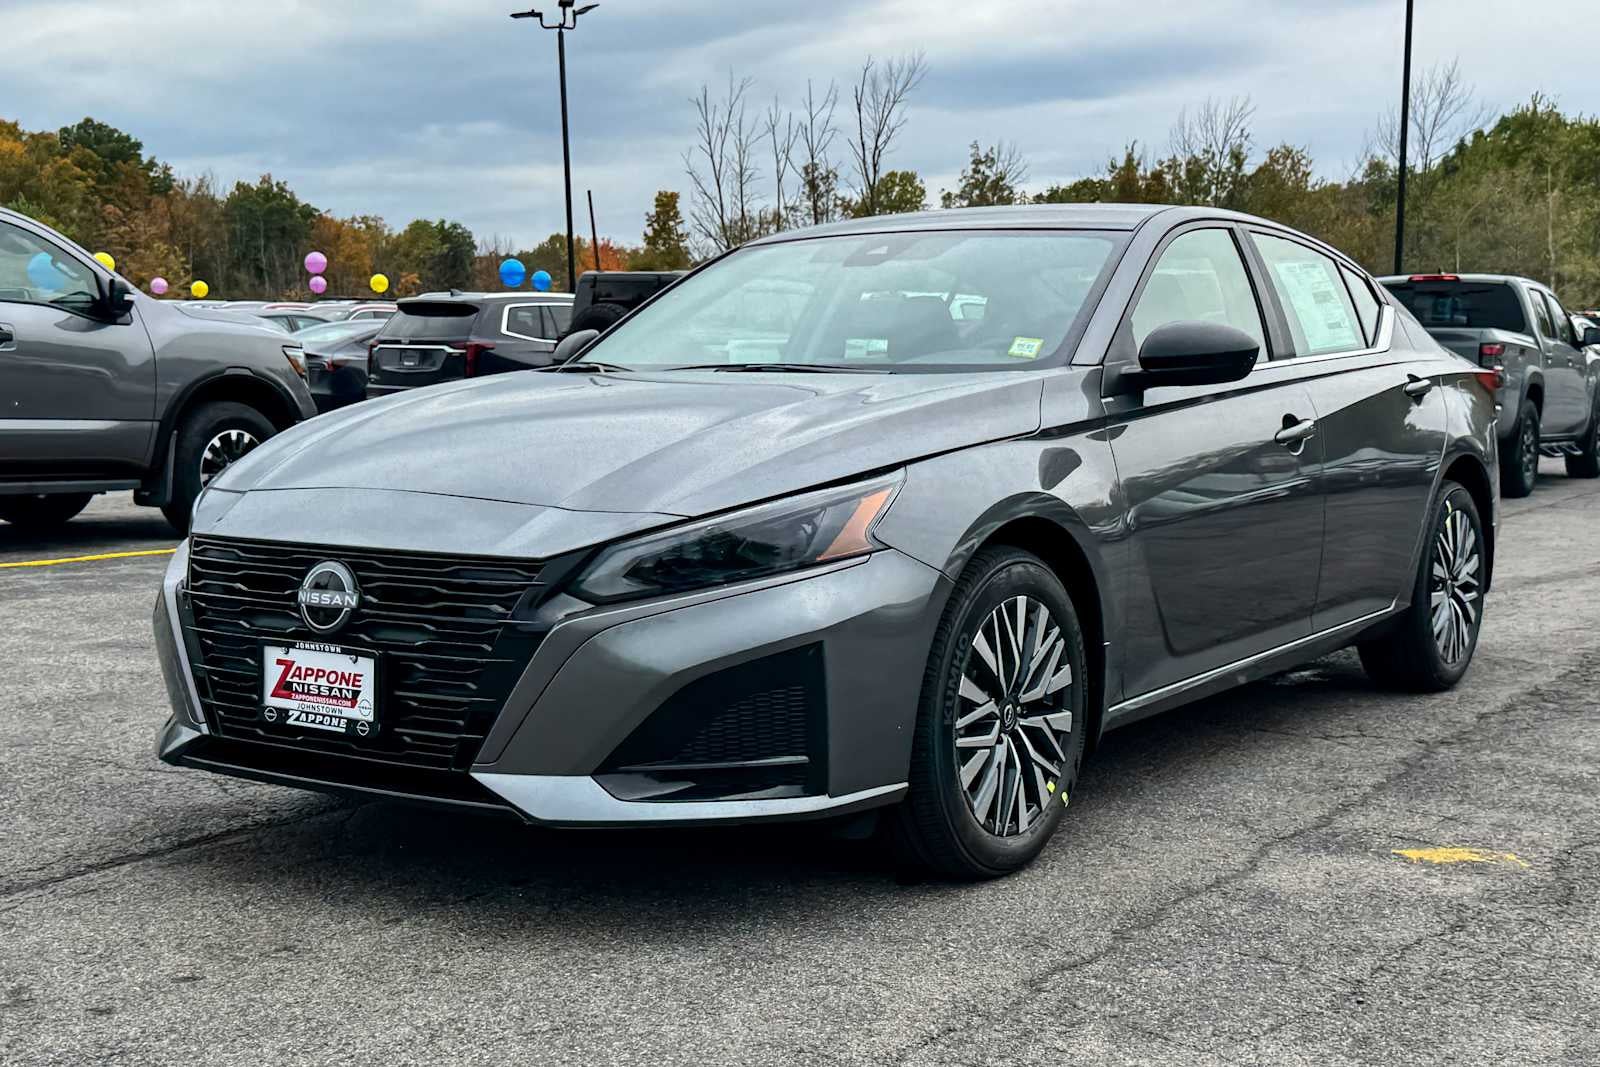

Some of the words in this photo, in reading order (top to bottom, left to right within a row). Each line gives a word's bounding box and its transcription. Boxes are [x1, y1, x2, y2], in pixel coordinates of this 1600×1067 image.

[298, 591, 356, 606] NISSAN
[295, 642, 342, 653] JOHNSTOWN
[270, 658, 364, 698] ZAPPONE
[292, 682, 353, 698] NISSAN
[291, 693, 352, 708] ZAPPONENISSAN.COM
[296, 702, 343, 715] JOHNSTOWN
[286, 710, 348, 732] ZAPPONE
